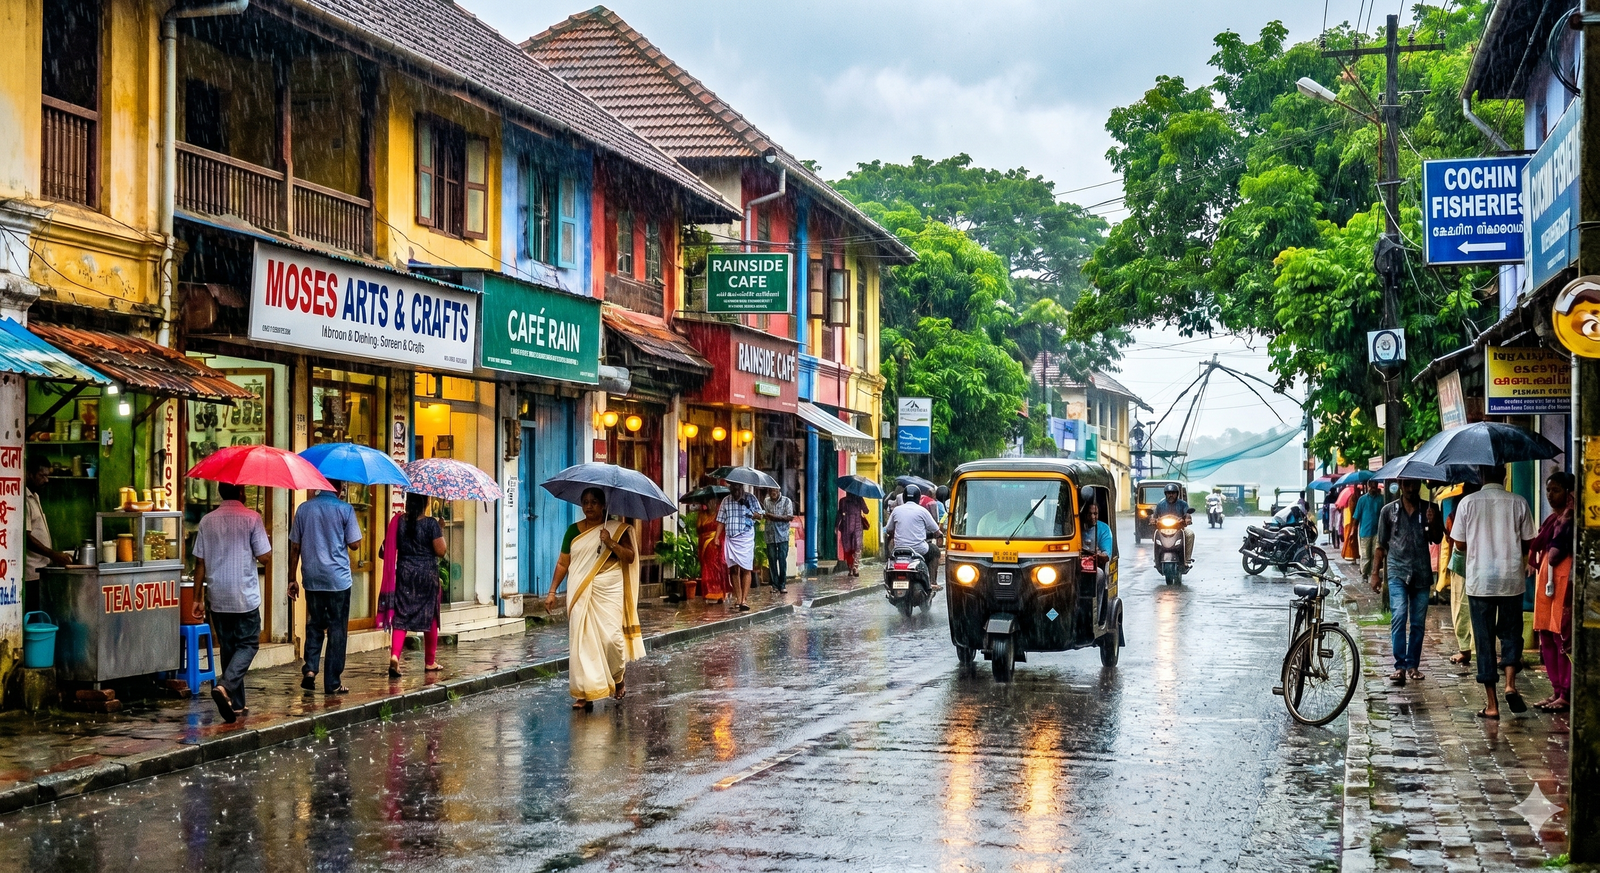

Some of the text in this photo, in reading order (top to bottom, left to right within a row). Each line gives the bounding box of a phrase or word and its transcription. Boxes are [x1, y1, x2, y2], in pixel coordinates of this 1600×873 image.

[1444, 165, 1516, 190] COCHIN
[712, 259, 784, 272] RAINSIDE
[728, 275, 767, 288] CAFE
[265, 259, 469, 343] MOSES ARTS & CRAFTS
[507, 307, 580, 353] CAFÉ RAIN
[738, 342, 796, 382] RAINSIDE CAFÉ
[102, 580, 179, 614] TEA STALL
